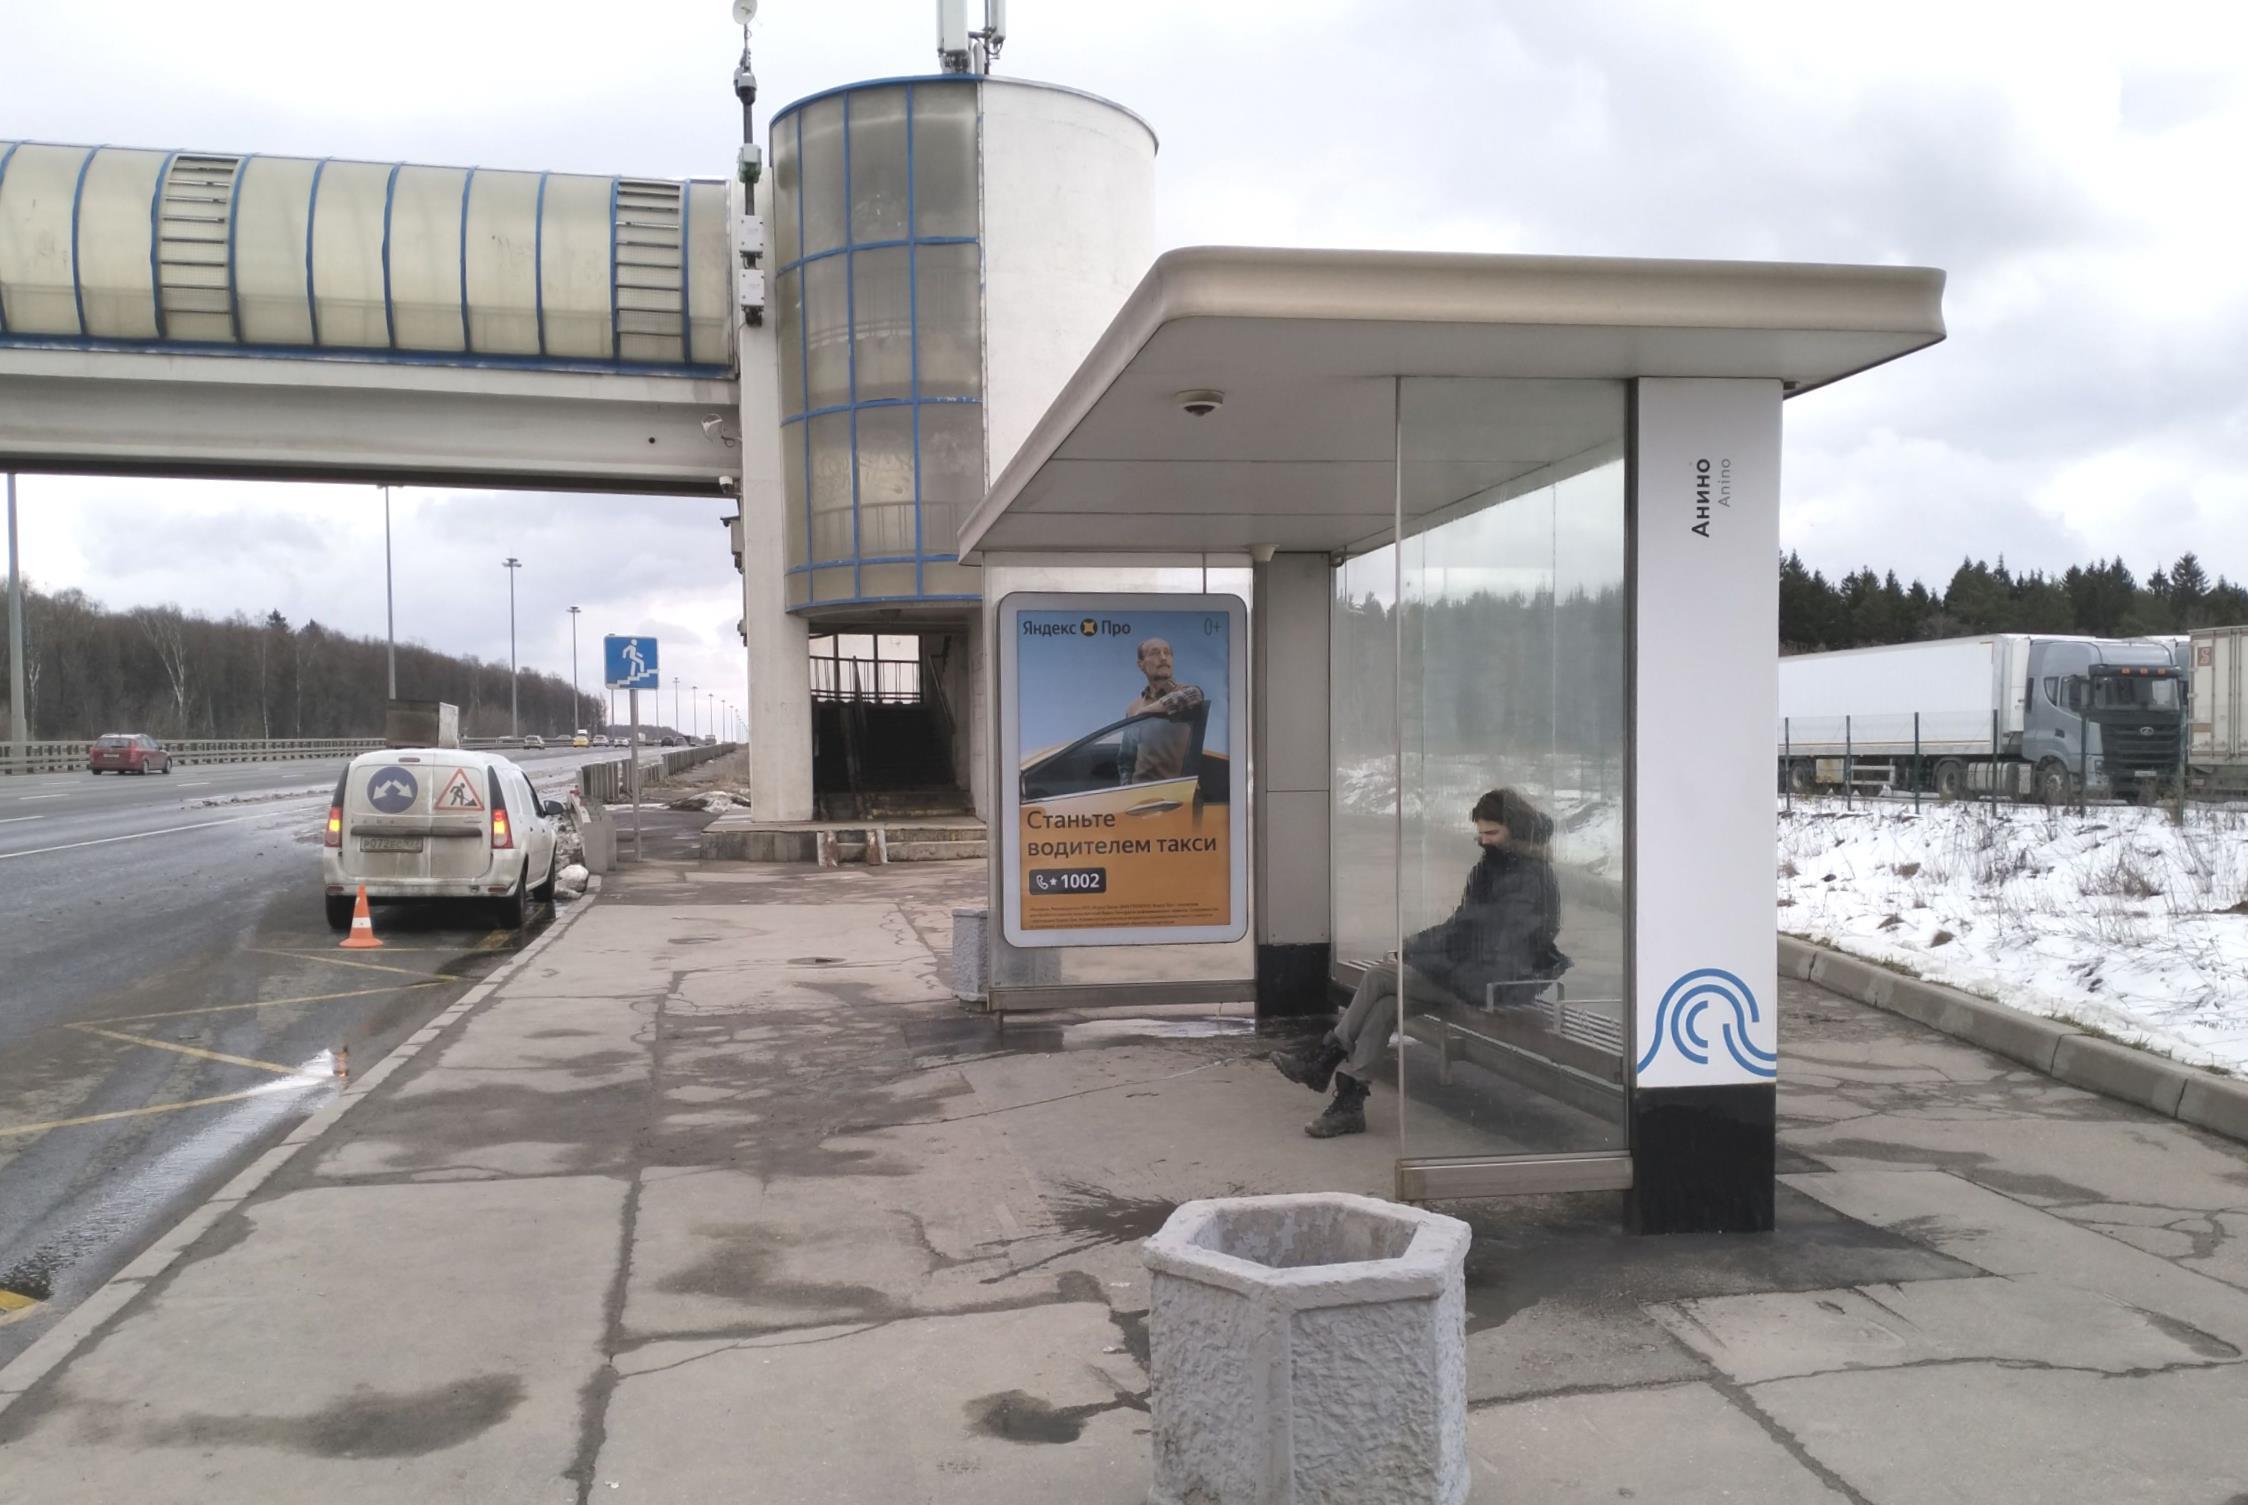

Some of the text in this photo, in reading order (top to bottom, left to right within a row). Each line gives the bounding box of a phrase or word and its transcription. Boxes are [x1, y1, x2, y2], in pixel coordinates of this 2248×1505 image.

[1717, 458, 1731, 508] Anino
[1691, 458, 1710, 538] Анино
[1023, 620, 1132, 637] Яндекс Про
[1204, 617, 1222, 636] 0+
[1027, 811, 1116, 829] Станьте
[1028, 837, 1216, 859] водителем такси
